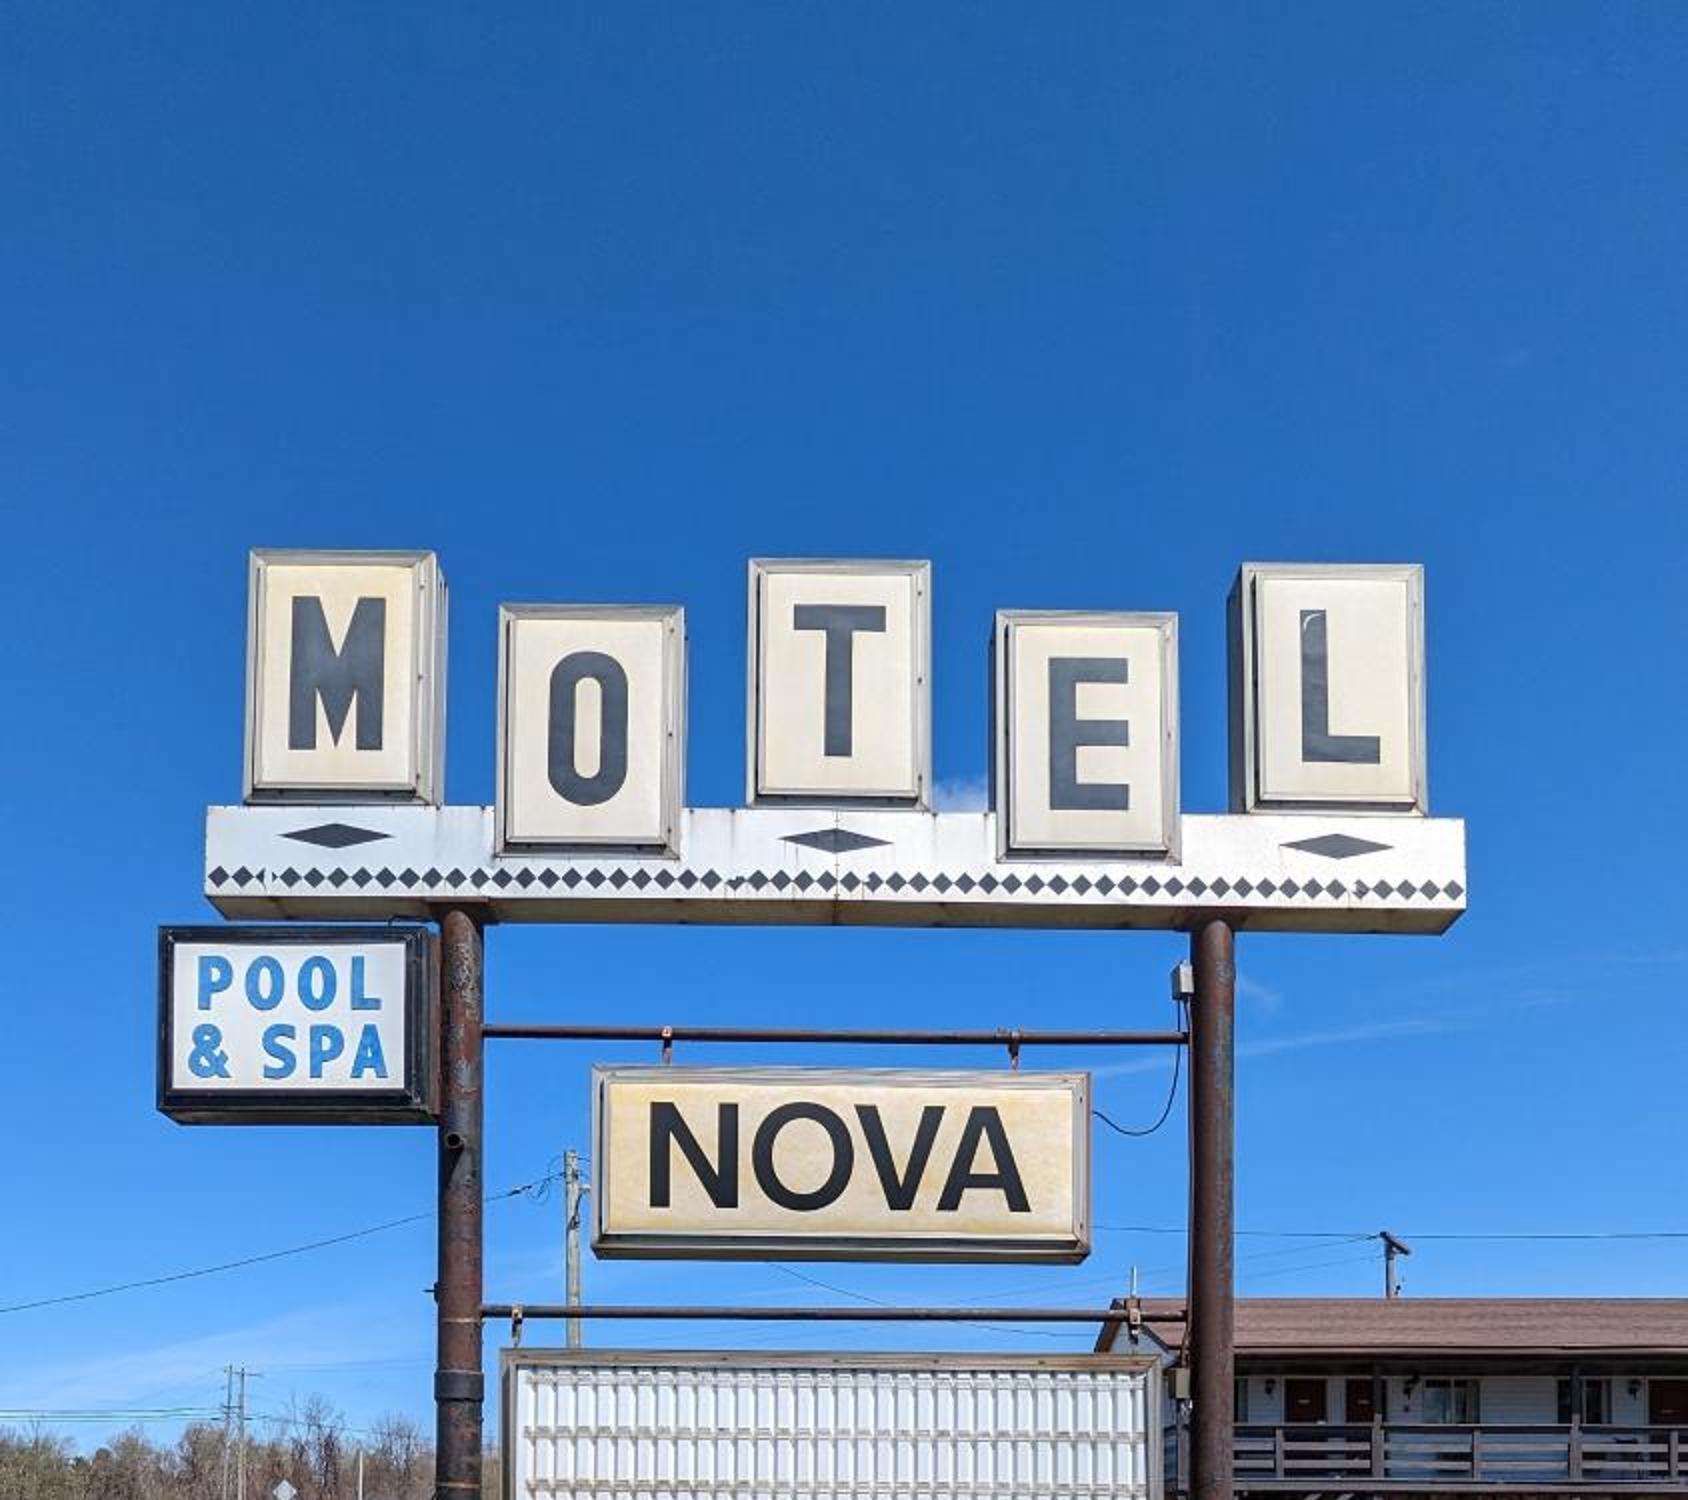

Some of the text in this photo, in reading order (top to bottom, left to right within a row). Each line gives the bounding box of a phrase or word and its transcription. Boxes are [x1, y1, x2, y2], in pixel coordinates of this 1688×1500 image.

[288, 596, 1381, 811] MOTEL
[197, 955, 382, 1011] POOL
[188, 1023, 388, 1079] & SPA
[649, 1101, 1032, 1213] NOVA
